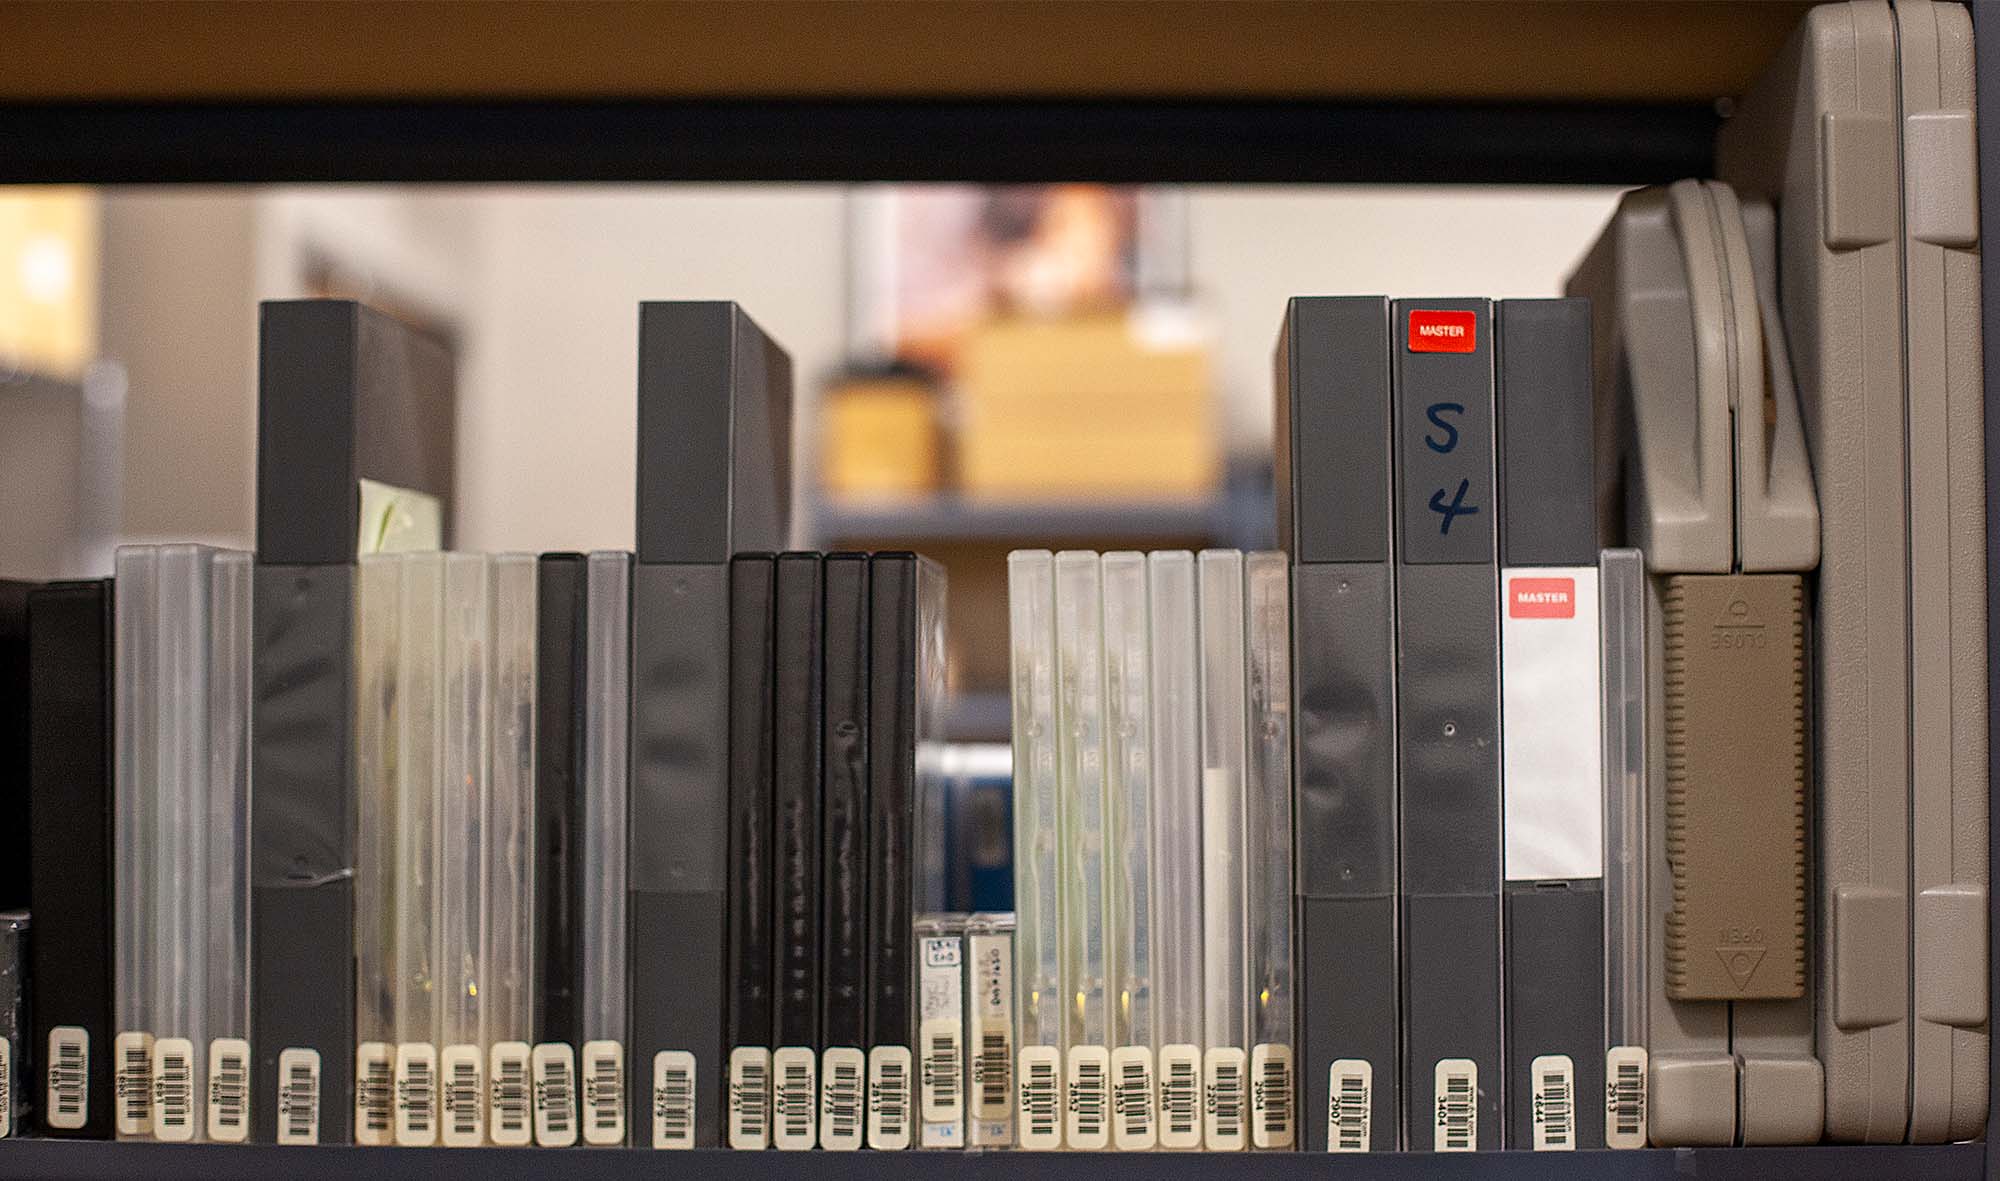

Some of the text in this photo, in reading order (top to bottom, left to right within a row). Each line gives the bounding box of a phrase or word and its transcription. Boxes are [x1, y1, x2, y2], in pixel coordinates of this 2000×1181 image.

[1420, 326, 1465, 337] MASTER
[1424, 402, 1465, 454] S
[1428, 478, 1480, 535] 4
[1518, 592, 1569, 604] MASTER
[1711, 632, 1767, 649] CLOSE
[1719, 927, 1763, 944] OPEN
[1022, 1082, 1031, 1112] 2851
[1069, 1082, 1079, 1112] 2852
[1255, 1080, 1264, 1111] 2904
[1331, 1095, 1340, 1127] 2907
[1437, 1095, 1447, 1127] 3404
[1535, 1093, 1545, 1125] 4644
[1607, 1081, 1617, 1113] 2913
